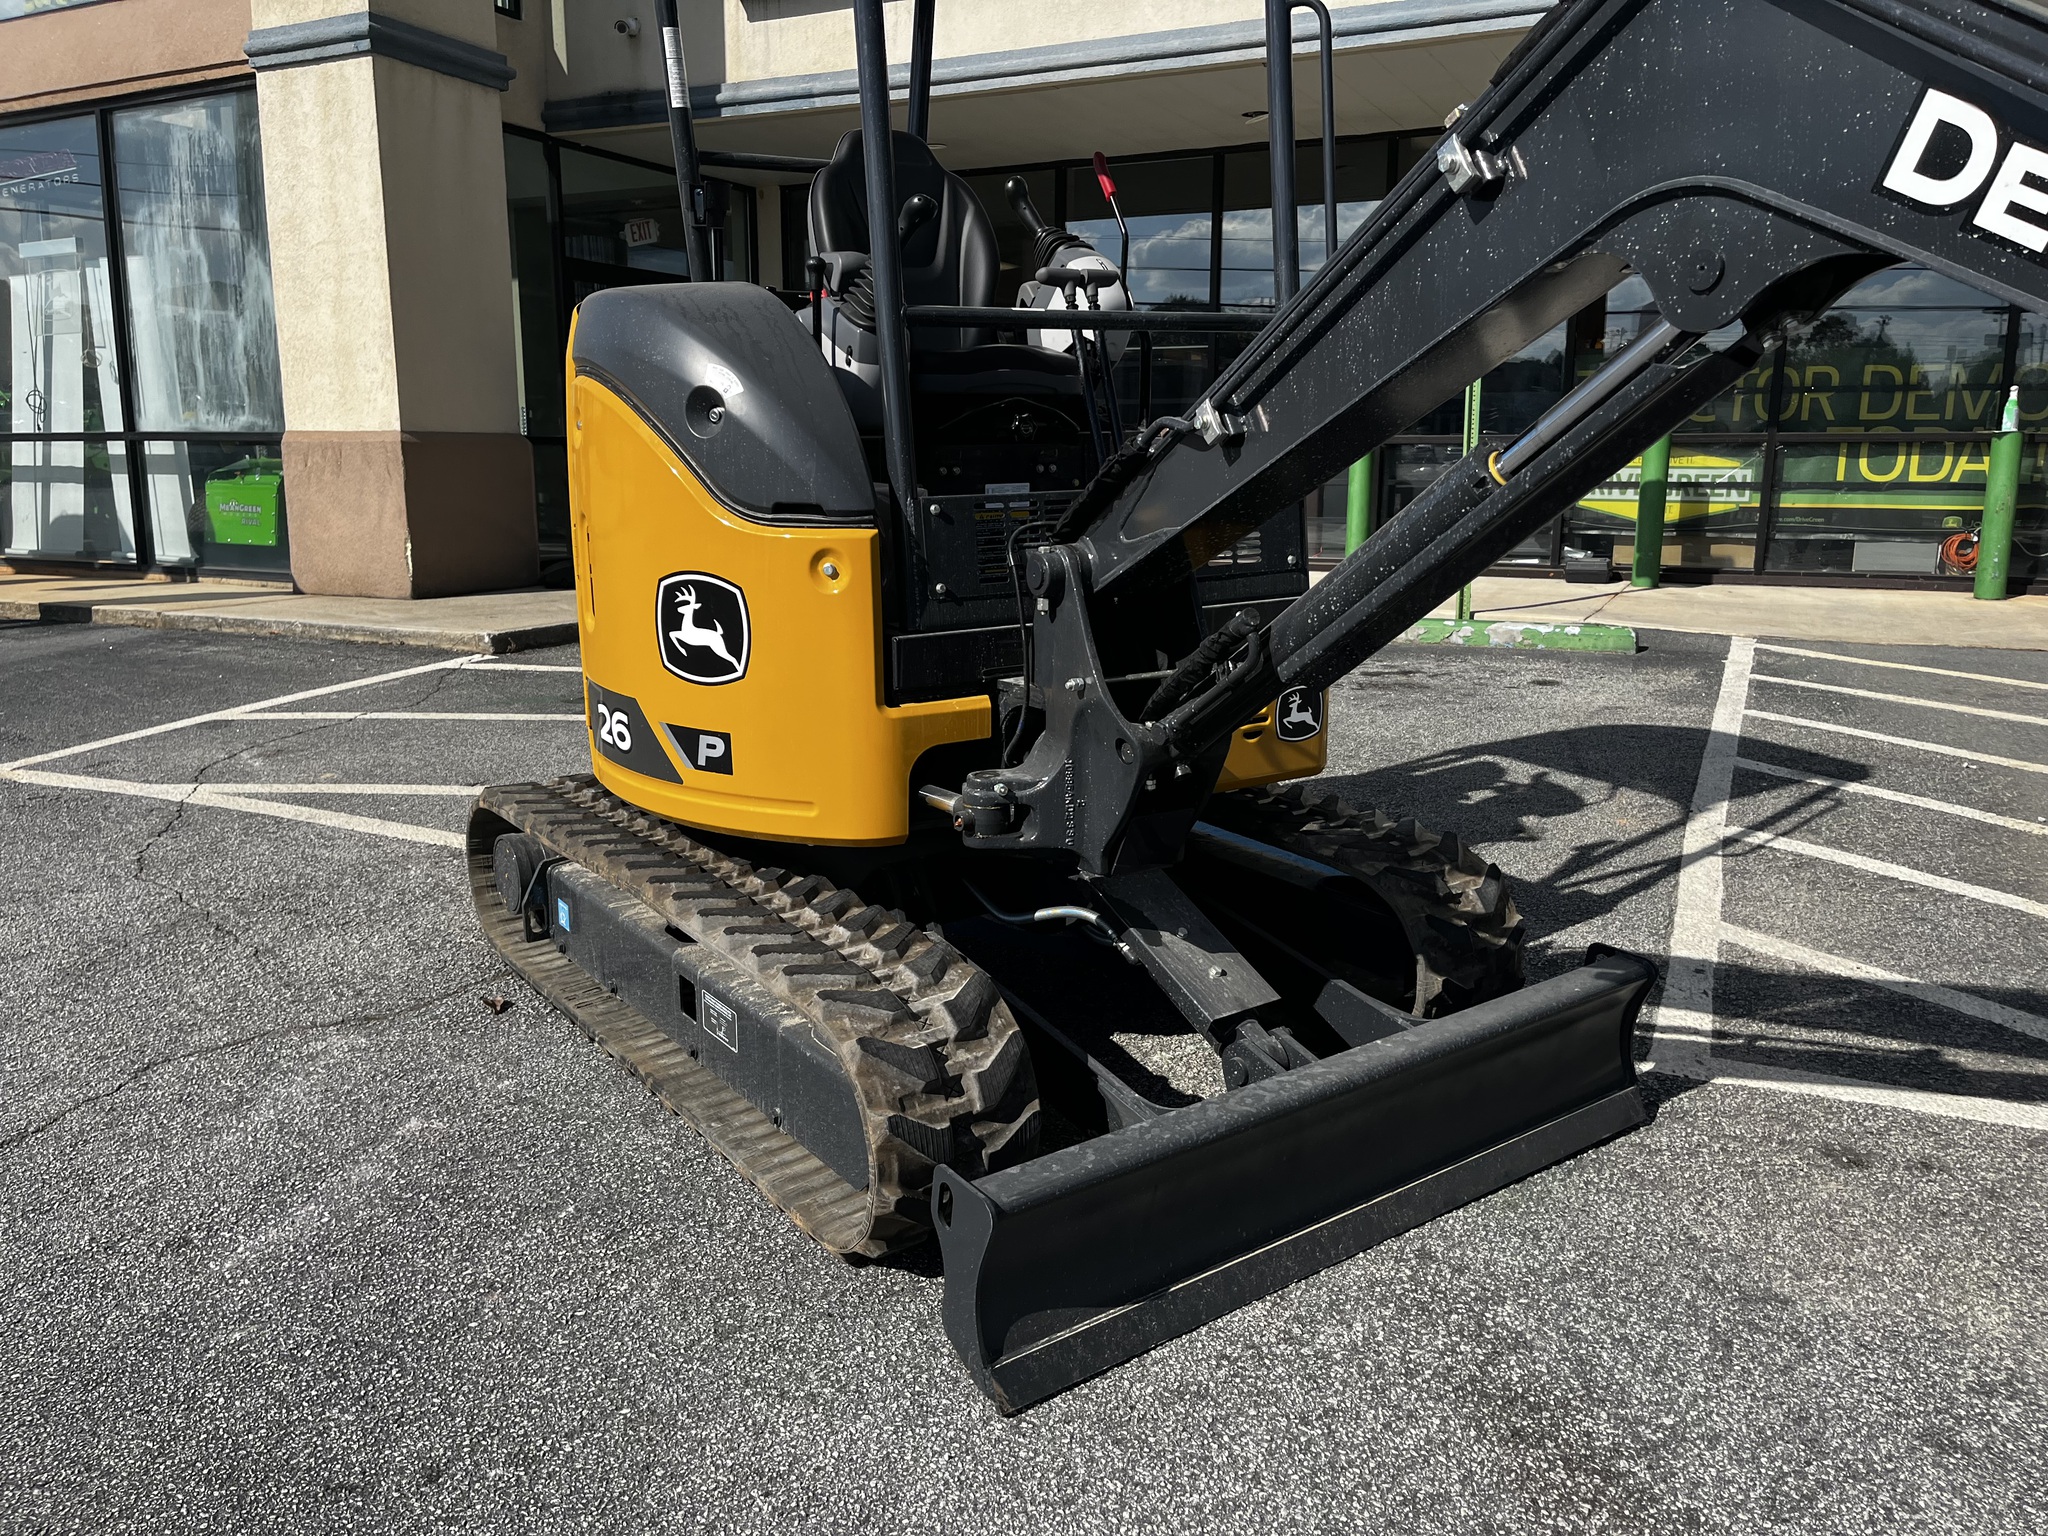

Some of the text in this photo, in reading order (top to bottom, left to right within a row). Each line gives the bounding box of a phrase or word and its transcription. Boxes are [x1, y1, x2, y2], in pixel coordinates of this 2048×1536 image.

[630, 221, 652, 243] EXIT
[597, 703, 632, 751] 26
[697, 734, 725, 766] P
